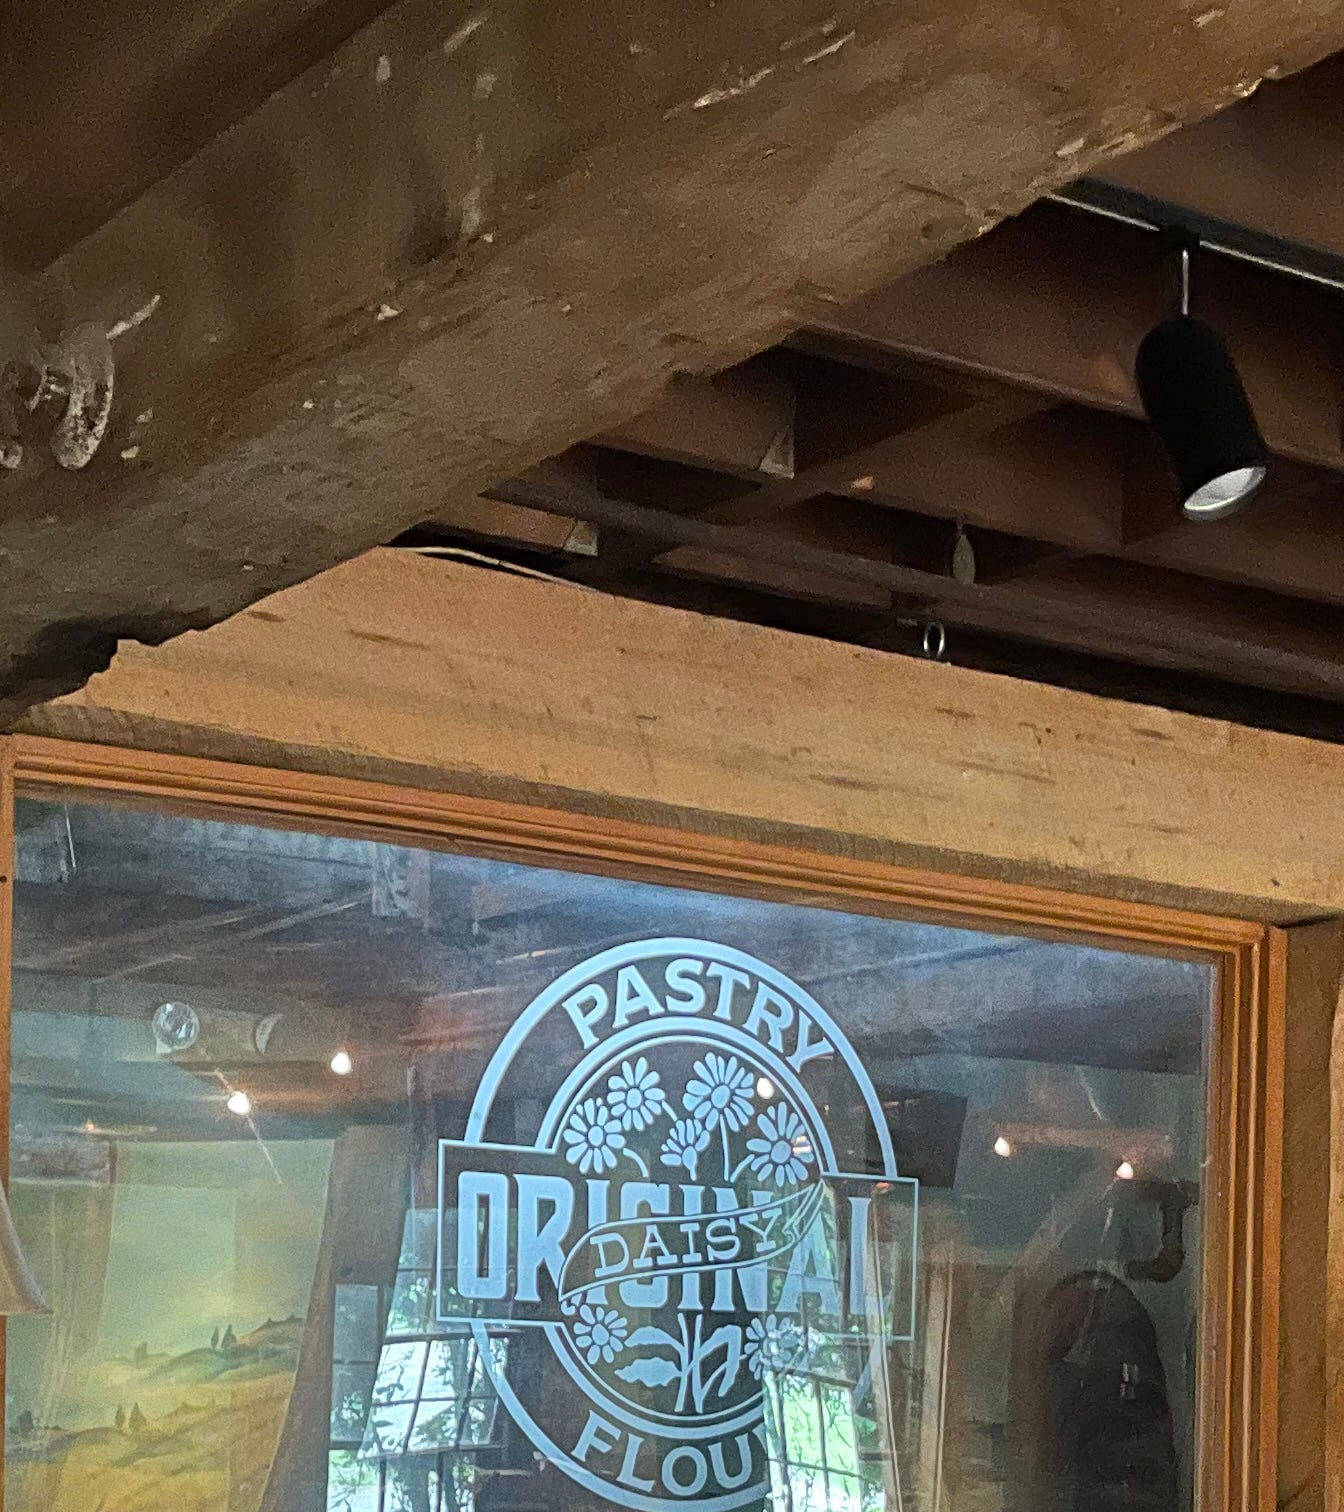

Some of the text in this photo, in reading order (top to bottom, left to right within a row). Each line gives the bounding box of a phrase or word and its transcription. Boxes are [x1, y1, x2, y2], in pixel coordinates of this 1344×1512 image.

[562, 957, 835, 1073] PASTRY
[590, 1207, 783, 1278] DAISY
[572, 1410, 768, 1496] FLOU
